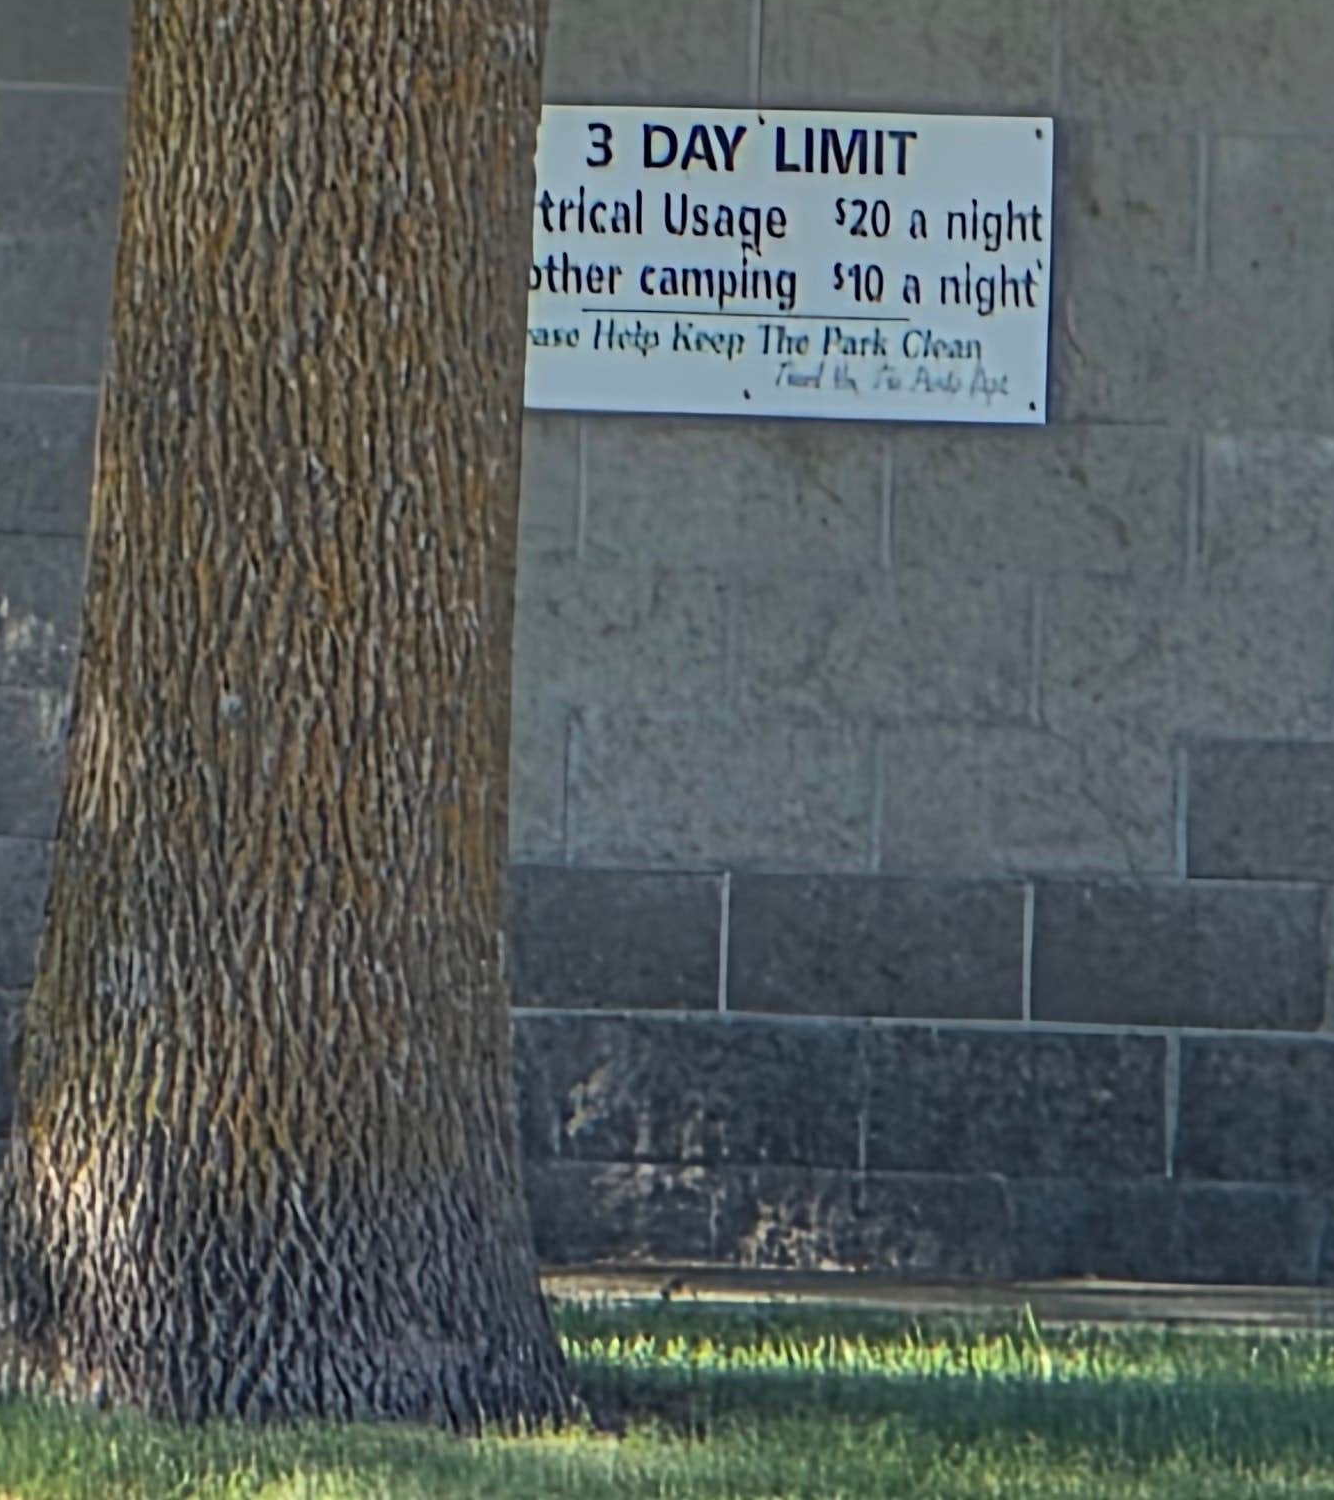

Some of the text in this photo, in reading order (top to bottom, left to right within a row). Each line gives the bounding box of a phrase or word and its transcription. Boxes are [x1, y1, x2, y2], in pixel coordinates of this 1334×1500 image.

[586, 121, 919, 177] 3 DAY LIMIT
[665, 192, 787, 257] Usage
[835, 198, 891, 238] $20
[910, 209, 927, 239] a
[947, 198, 1043, 252] night
[528, 251, 1038, 316] other camping $10 a night
[528, 318, 983, 364] ase Help Keep The Park Clean
